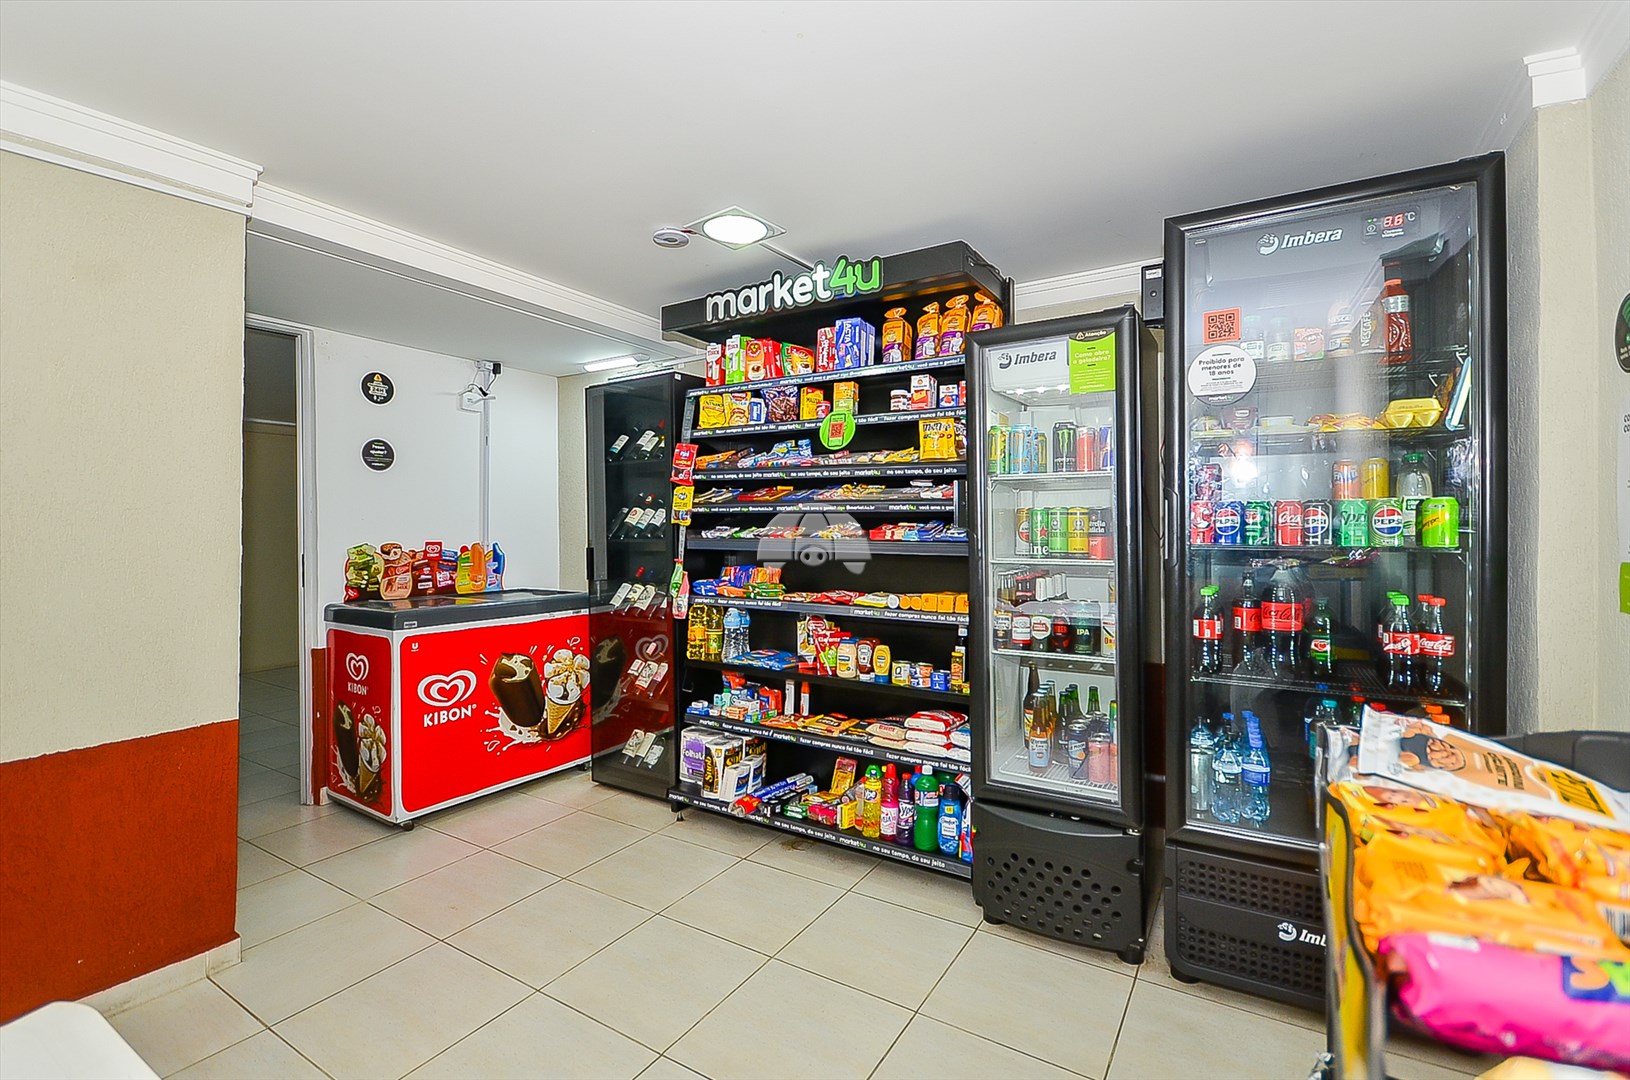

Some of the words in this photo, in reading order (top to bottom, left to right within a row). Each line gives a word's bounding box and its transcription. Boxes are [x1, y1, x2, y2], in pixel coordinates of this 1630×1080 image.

[1281, 228, 1343, 249] Imbera
[706, 259, 880, 322] market4u
[1014, 351, 1057, 366] Imbera
[1199, 358, 1225, 367] Proibido
[1201, 364, 1231, 372] menores
[1077, 628, 1090, 636] IPA
[348, 682, 367, 695] KIBON
[424, 705, 472, 727] KIBON
